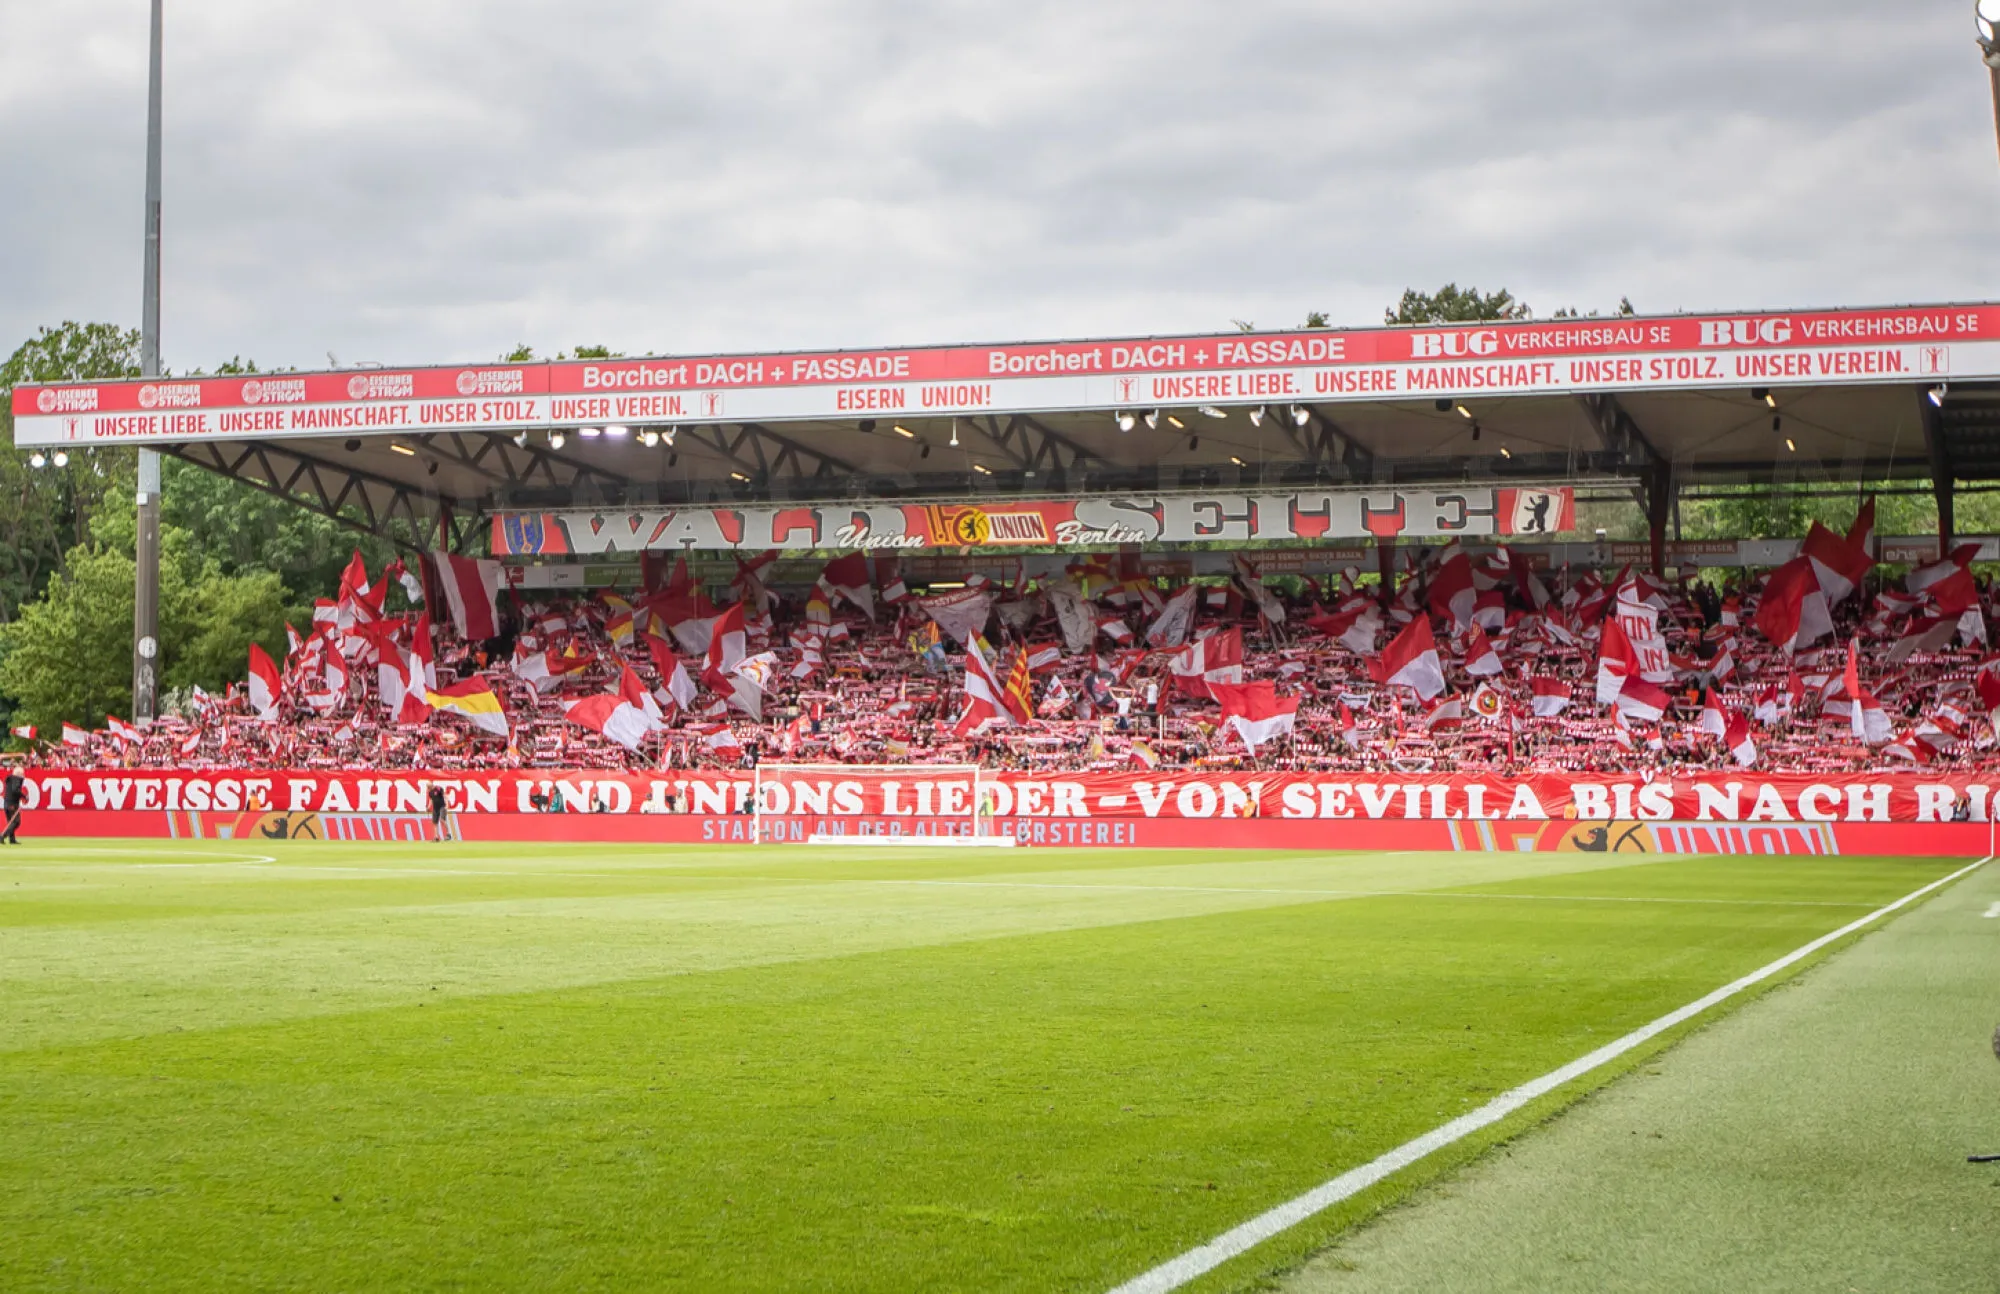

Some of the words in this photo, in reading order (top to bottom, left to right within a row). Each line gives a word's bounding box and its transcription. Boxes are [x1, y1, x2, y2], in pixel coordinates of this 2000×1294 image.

[1412, 331, 1497, 357] BUG
[1505, 328, 1642, 348] VERKEHRSBAU
[1650, 327, 1669, 342] SE
[1700, 319, 1791, 345] BUG
[1802, 317, 1948, 337] VERKEHRSBAU
[1957, 315, 1976, 331] SE
[989, 349, 1102, 373] Borchert
[1112, 345, 1184, 368] DACH
[1218, 338, 1344, 364] FASSADE
[584, 365, 687, 388] Borchert
[696, 362, 763, 384] DACH
[793, 356, 910, 380] FASSADE
[1153, 376, 1230, 399] UNSERE
[1238, 373, 1300, 395] LIEBE.
[1315, 370, 1395, 393] UNSERE
[1407, 363, 1559, 390] MANNSCHAFT.
[1570, 360, 1642, 383] UNSER
[1650, 357, 1723, 380] STOLZ.
[1736, 354, 1811, 377] UNSER
[1818, 351, 1909, 375] VEREIN.
[837, 389, 904, 410] EISERN
[922, 386, 990, 407] UNION!
[95, 416, 156, 436] UNSERE
[162, 414, 212, 434] LIEBE.
[220, 411, 283, 432] UNSERE
[292, 405, 412, 428] MANNSCHAFT.
[420, 403, 476, 424] UNSER
[482, 400, 541, 422] STOLZ.
[552, 399, 609, 420] UNSER
[616, 396, 687, 417] VEREIN.
[557, 508, 906, 554] WALD
[1076, 494, 1495, 543] SEITE
[834, 524, 924, 549] Union
[991, 515, 1046, 540] UNION
[1054, 520, 1146, 544] Berlin
[0, 778, 272, 810] OT-WEISSE
[288, 780, 500, 812] FAHNEN
[516, 780, 631, 813] UND
[650, 780, 863, 816] UNIONS
[881, 781, 1091, 818] LIEDER
[1132, 782, 1260, 818] VON
[1282, 783, 1549, 819] SEVILLA
[1571, 780, 1674, 820] BIS
[1693, 782, 1892, 821] NACH
[1914, 784, 2000, 822] RI
